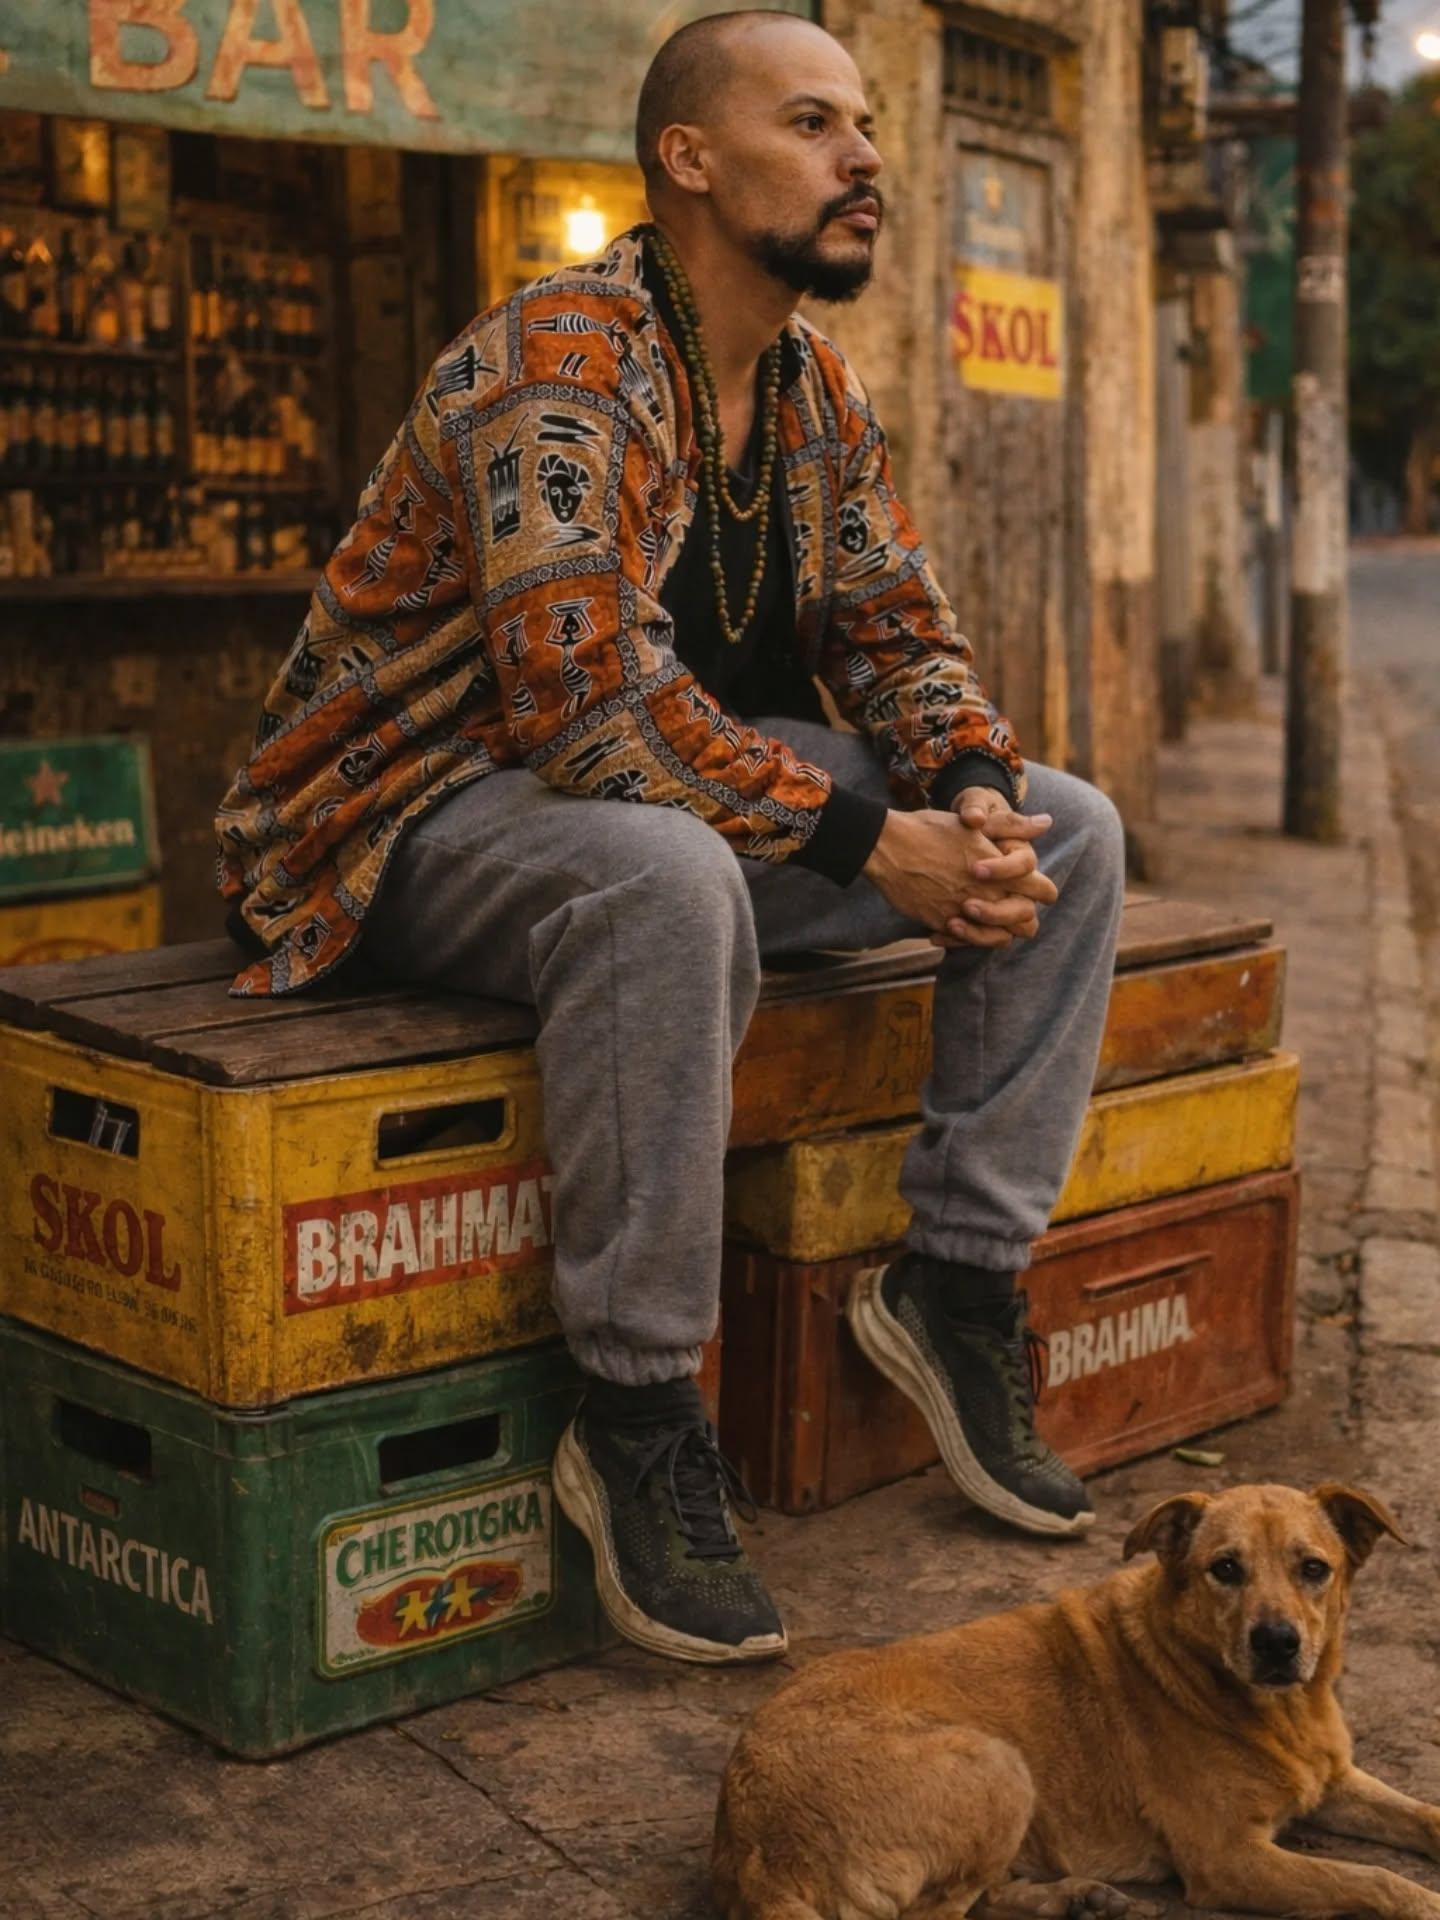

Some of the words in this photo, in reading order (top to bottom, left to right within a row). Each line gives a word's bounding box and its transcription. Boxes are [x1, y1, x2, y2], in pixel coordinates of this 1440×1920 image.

[89, 0, 440, 120] BAR
[951, 290, 1058, 368] SKOL
[0, 816, 135, 860] eineken
[30, 1172, 182, 1293] SKOL
[1047, 1293, 1195, 1388] BRAHMA
[18, 1497, 213, 1625] ANTARCTICA
